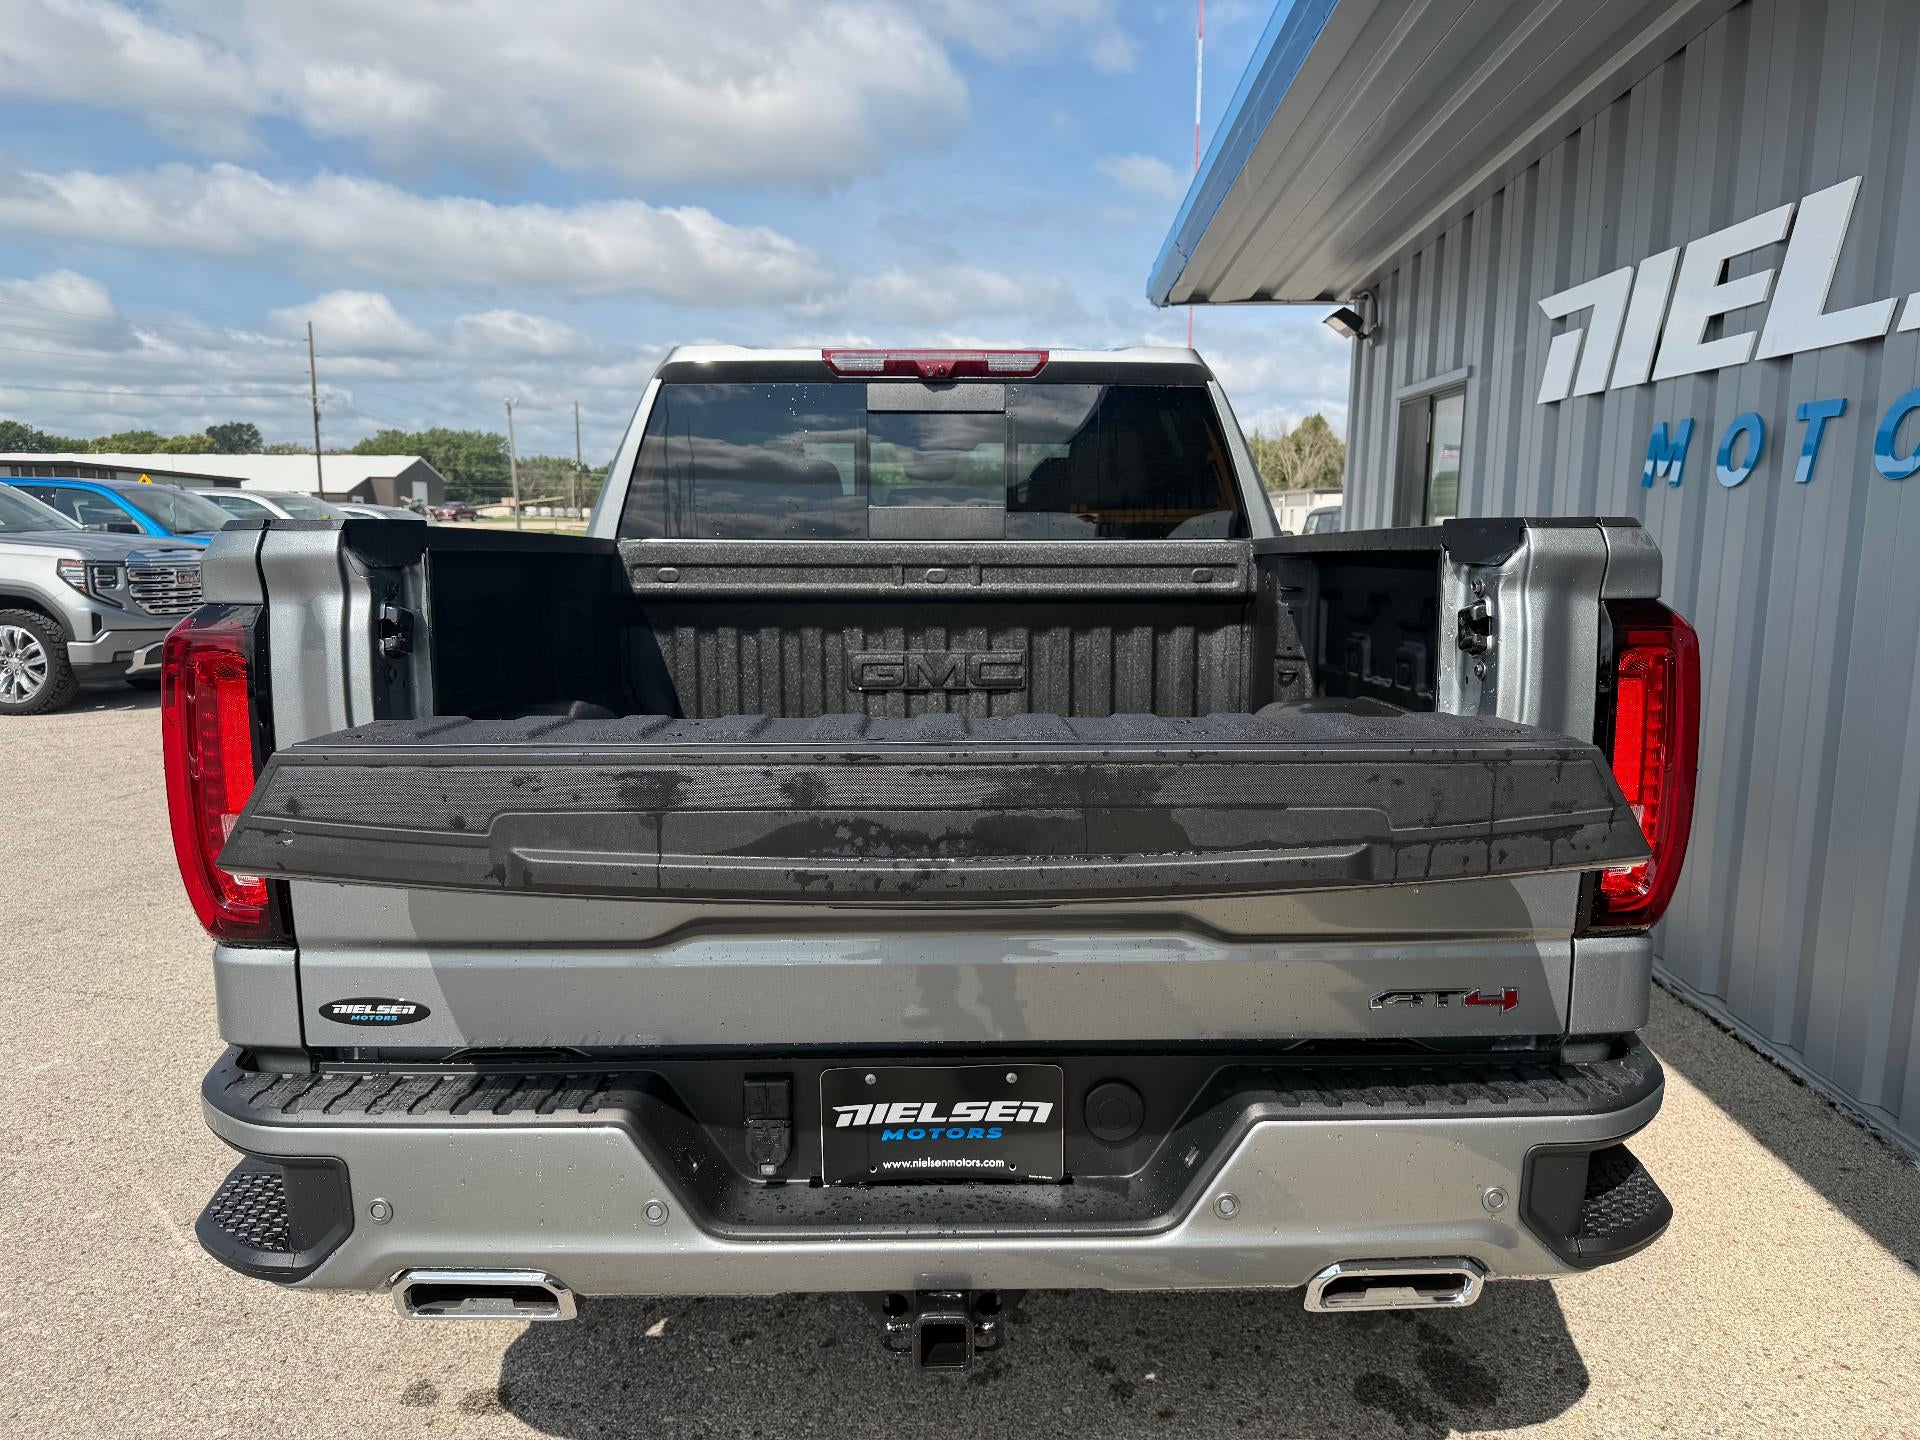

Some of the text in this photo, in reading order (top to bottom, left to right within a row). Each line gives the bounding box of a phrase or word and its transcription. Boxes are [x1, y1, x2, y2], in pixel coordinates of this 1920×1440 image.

[851, 654, 1022, 687] GMC
[332, 1004, 416, 1014] NIELSEN
[1369, 986, 1519, 1015] AT4
[832, 1101, 1053, 1127] NIELSEN
[881, 1127, 1003, 1141] MOTORS
[883, 1156, 1005, 1169] www.nielsenmotors.com
